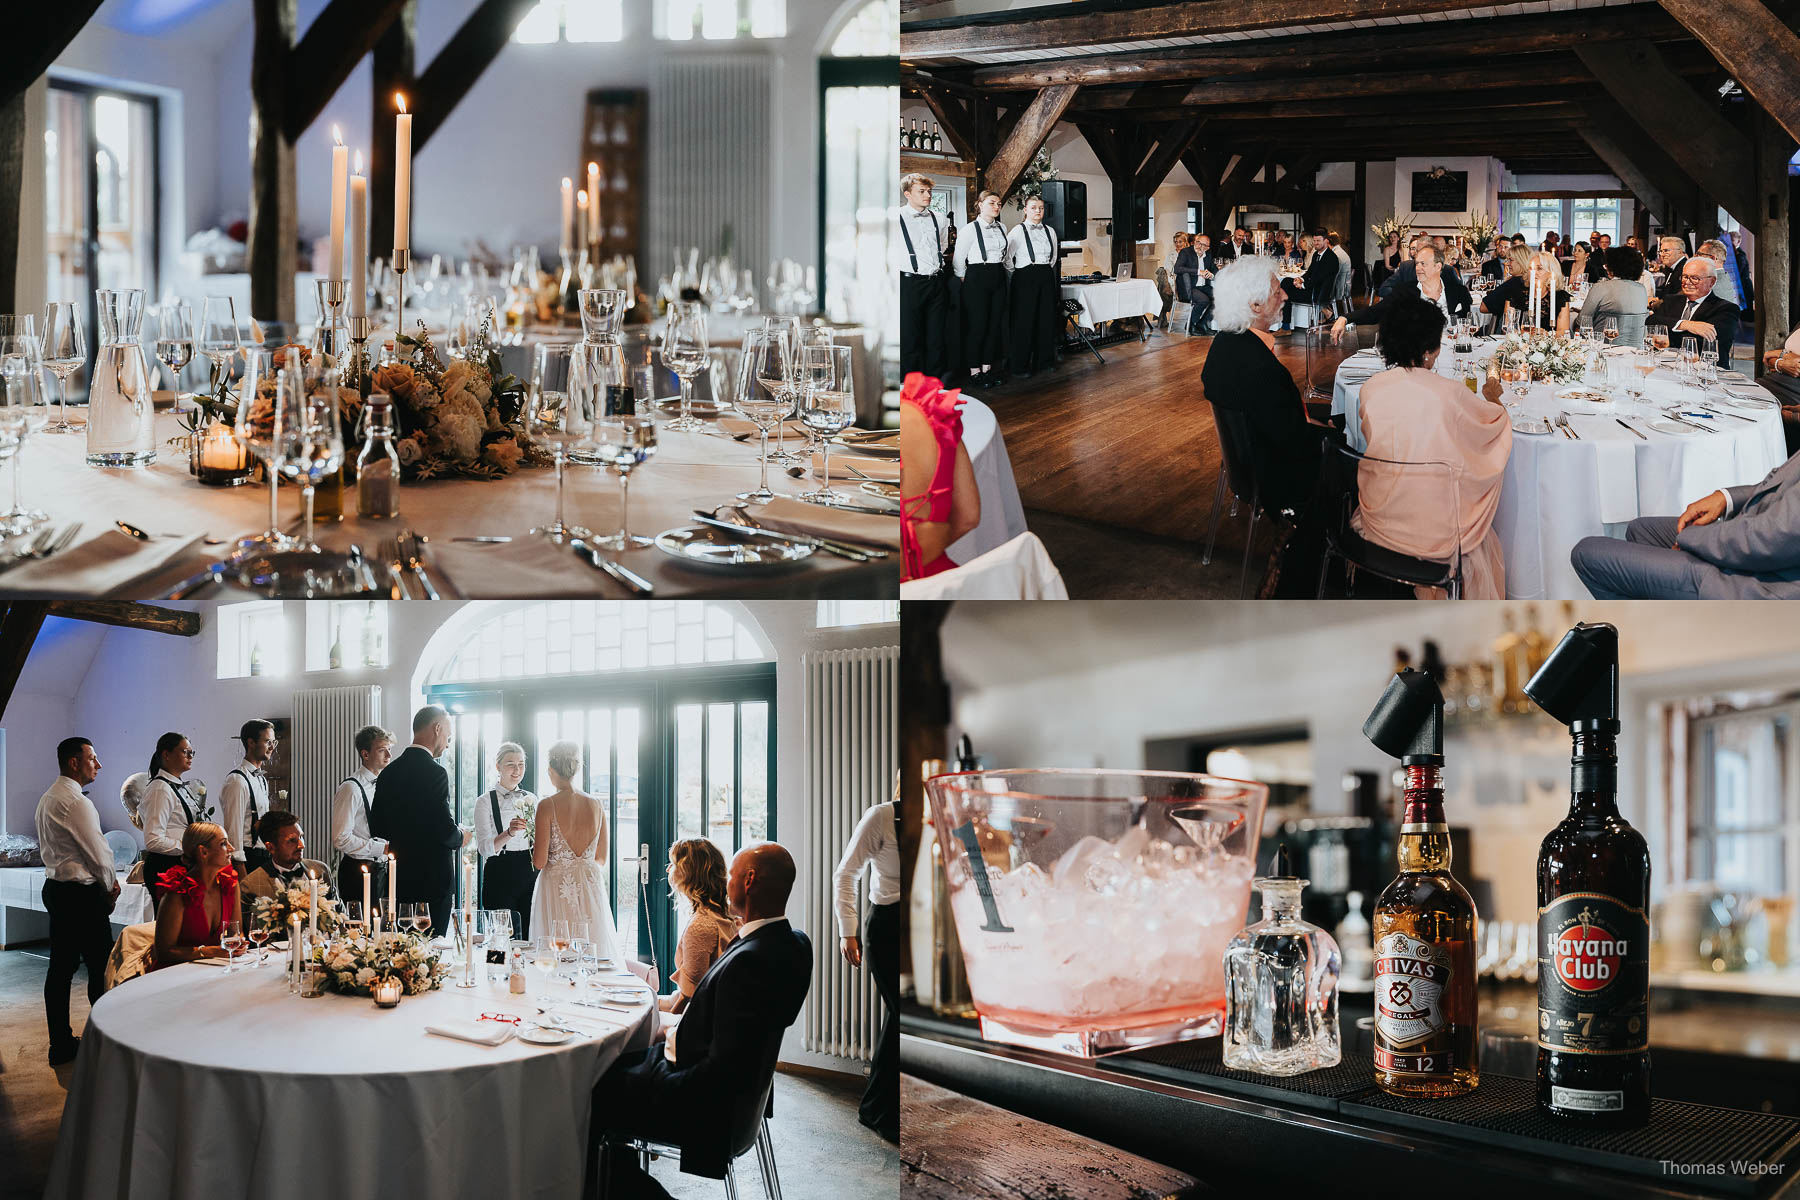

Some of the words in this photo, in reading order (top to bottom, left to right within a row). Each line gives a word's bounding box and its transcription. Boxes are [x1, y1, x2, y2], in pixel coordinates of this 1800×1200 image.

[1547, 932, 1628, 957] Havana
[1376, 959, 1436, 978] CHIVAS
[1561, 957, 1610, 980] Club
[1389, 1011, 1414, 1019] REGAL
[1577, 1012, 1595, 1038] 7
[1416, 1057, 1434, 1072] 12
